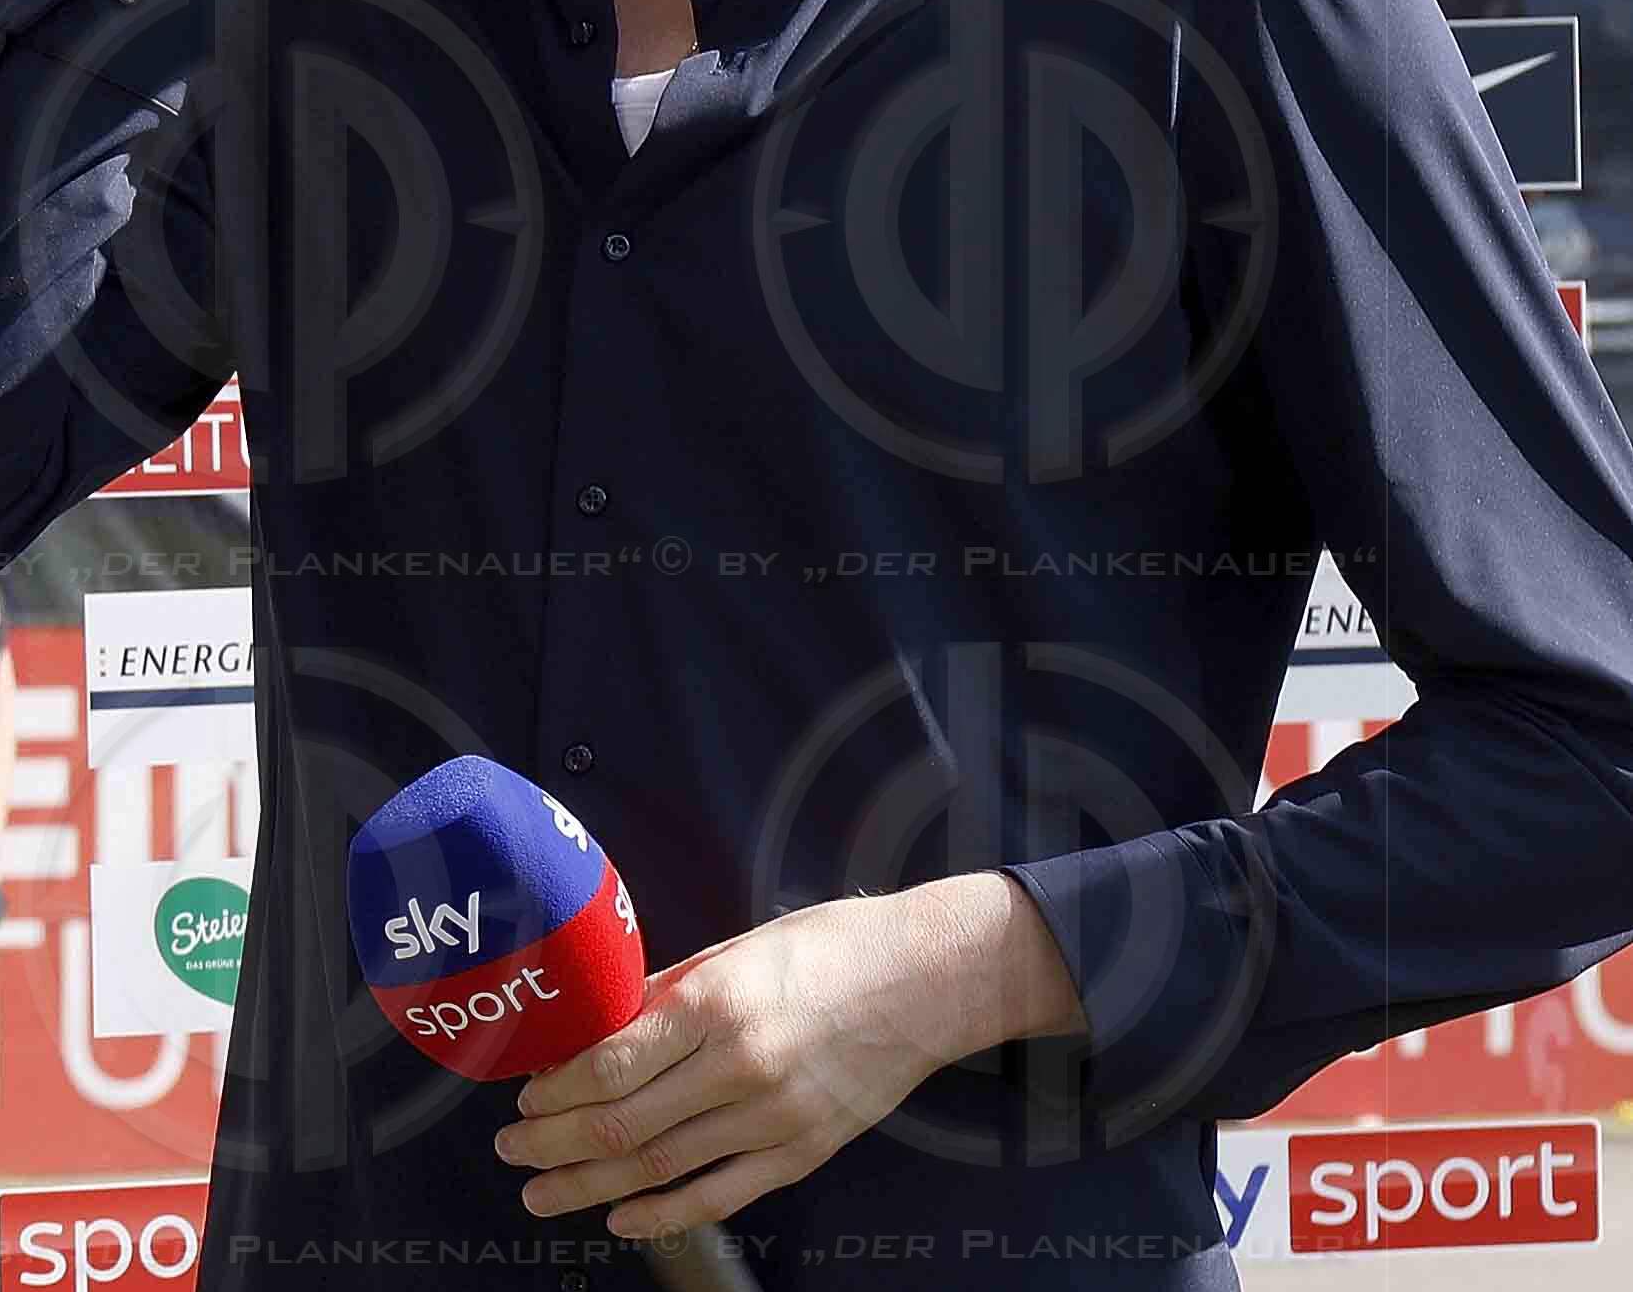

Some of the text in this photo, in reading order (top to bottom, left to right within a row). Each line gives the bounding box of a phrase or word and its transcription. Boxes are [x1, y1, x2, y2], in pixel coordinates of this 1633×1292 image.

[384, 890, 484, 961] sky
[405, 963, 561, 1041] sport
[1309, 1141, 1579, 1242] sport
